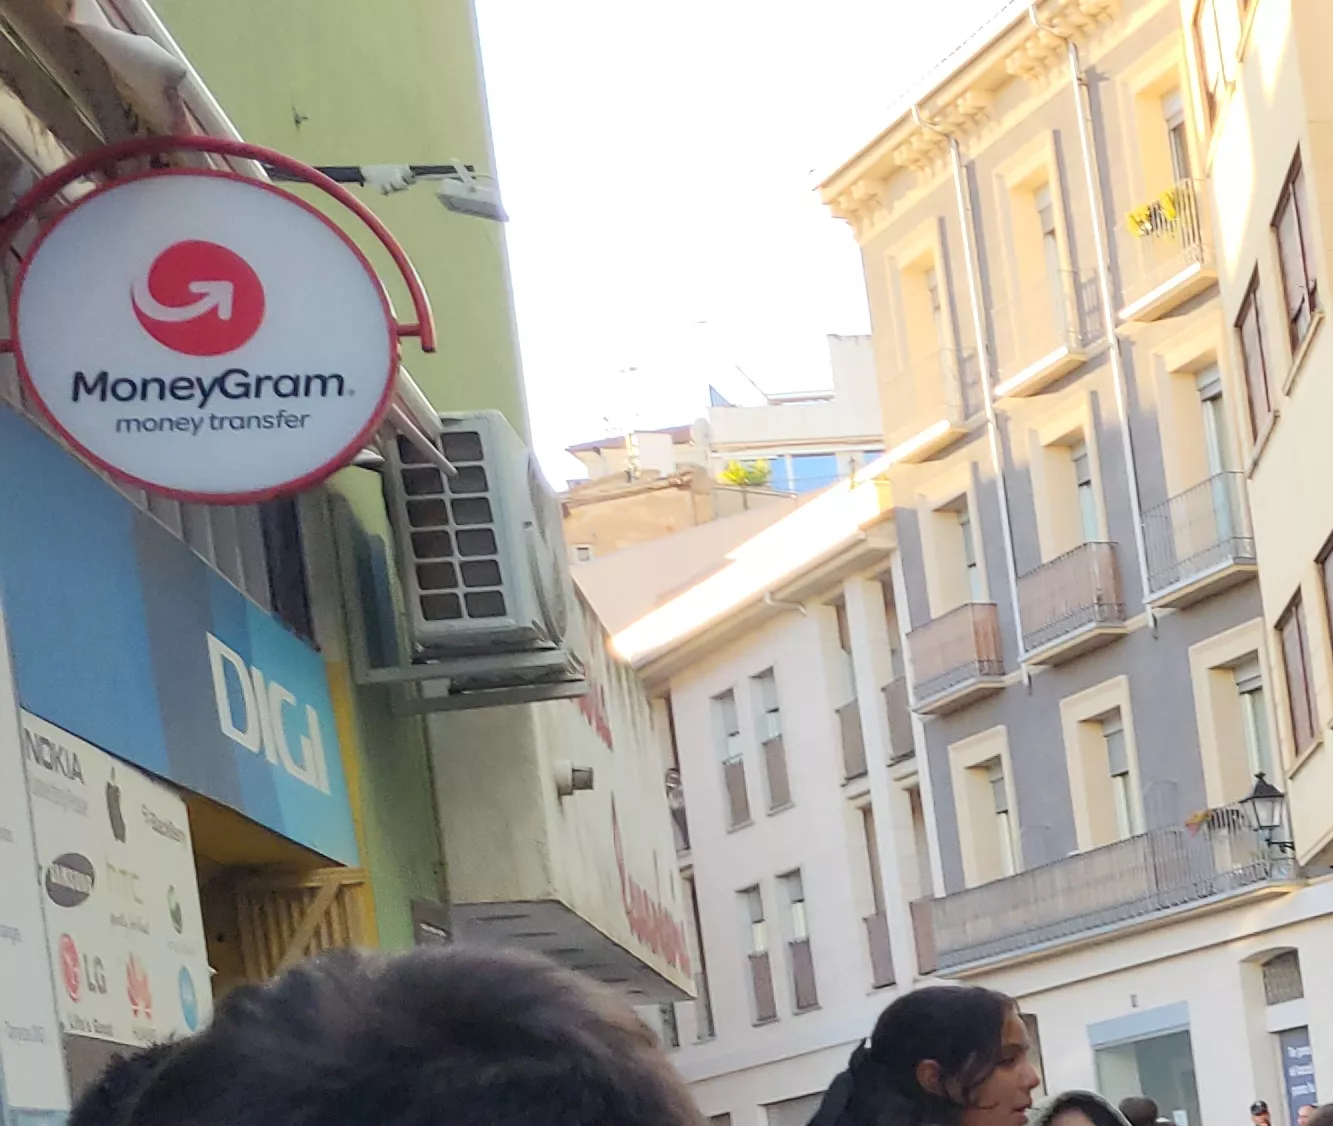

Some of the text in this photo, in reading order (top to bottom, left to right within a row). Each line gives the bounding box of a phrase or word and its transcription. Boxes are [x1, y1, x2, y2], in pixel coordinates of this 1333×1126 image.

[115, 410, 311, 436] money transfer
[205, 631, 332, 796] DIGI
[24, 727, 85, 786] NOKIA
[83, 953, 108, 994] LG
